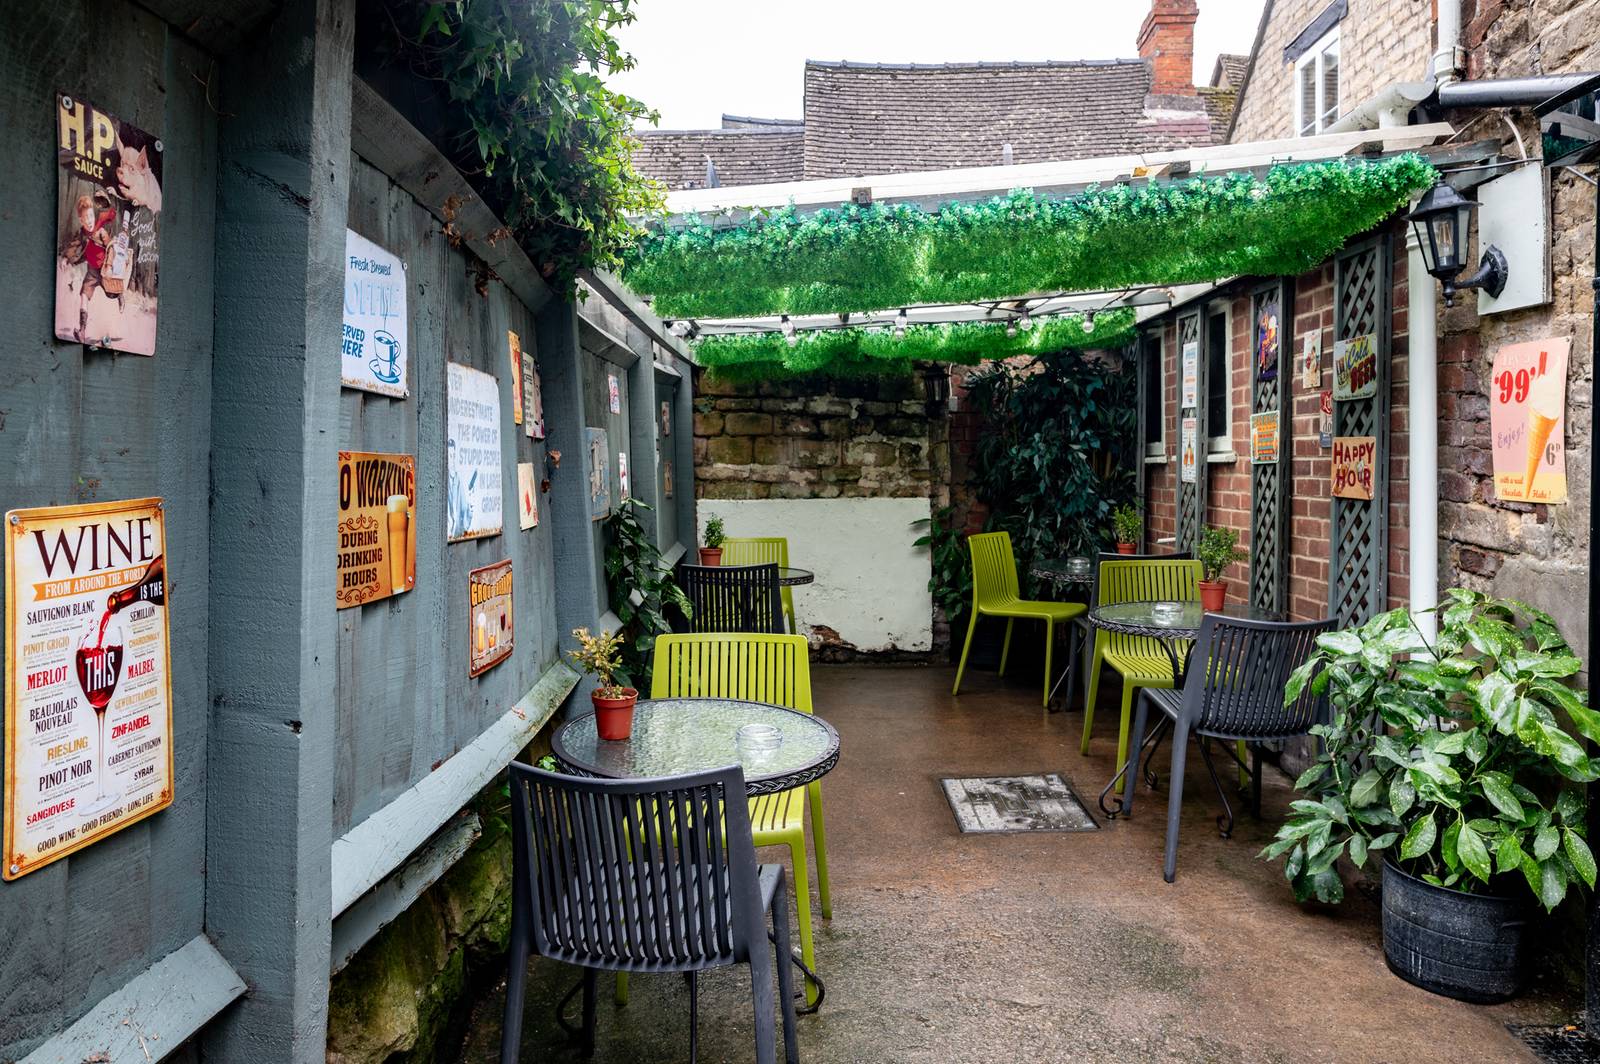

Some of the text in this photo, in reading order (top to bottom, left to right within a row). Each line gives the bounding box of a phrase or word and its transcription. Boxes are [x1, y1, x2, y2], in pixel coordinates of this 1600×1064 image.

[74, 156, 104, 180] SAUCE
[131, 211, 155, 237] Good
[136, 234, 158, 250] with
[137, 252, 159, 265] bacon
[350, 256, 392, 276] Fresh Brewed
[342, 323, 365, 342] ERVED
[1347, 336, 1369, 369] Cold
[1350, 353, 1377, 394] BEER
[448, 396, 493, 422] NDERESTIMATE
[457, 423, 498, 446] THE POWER OF
[1497, 422, 1525, 449] Enjoy!
[459, 447, 501, 468] STUPID PEOPLE
[1334, 442, 1375, 464] HAPPY
[340, 459, 414, 511] O WORKING
[1335, 467, 1371, 488] HOUR
[31, 517, 154, 578] WINE
[341, 530, 378, 549] DURING
[45, 567, 146, 598] FROM AROUND THE WORLD
[140, 580, 163, 600] IS THE
[343, 568, 377, 588] HOURS
[27, 600, 96, 626] SAUVIGNON BLANC
[23, 636, 70, 657] PINOT GRIGIO
[27, 665, 69, 690] MERLOT
[85, 651, 115, 693] THIS
[127, 658, 155, 679] MALBEC
[29, 697, 78, 722] BEAUJOLAIS
[35, 711, 73, 734] NOUVEAU
[111, 714, 151, 740] ZINFANDEL
[47, 736, 89, 761] RIESLING
[107, 749, 135, 767] CABERNET
[134, 736, 162, 755] SAUVIGNON
[39, 768, 68, 792] PINOT
[70, 759, 92, 777] NOIR
[134, 764, 154, 781] SYRAH
[26, 798, 75, 826] SANGIOVESE
[37, 838, 57, 853] GOOD
[58, 828, 77, 844] WINE
[81, 820, 98, 834] GOOD
[99, 806, 124, 826] FRIENDS
[127, 798, 142, 813] LONG
[142, 792, 154, 806] LIFE
